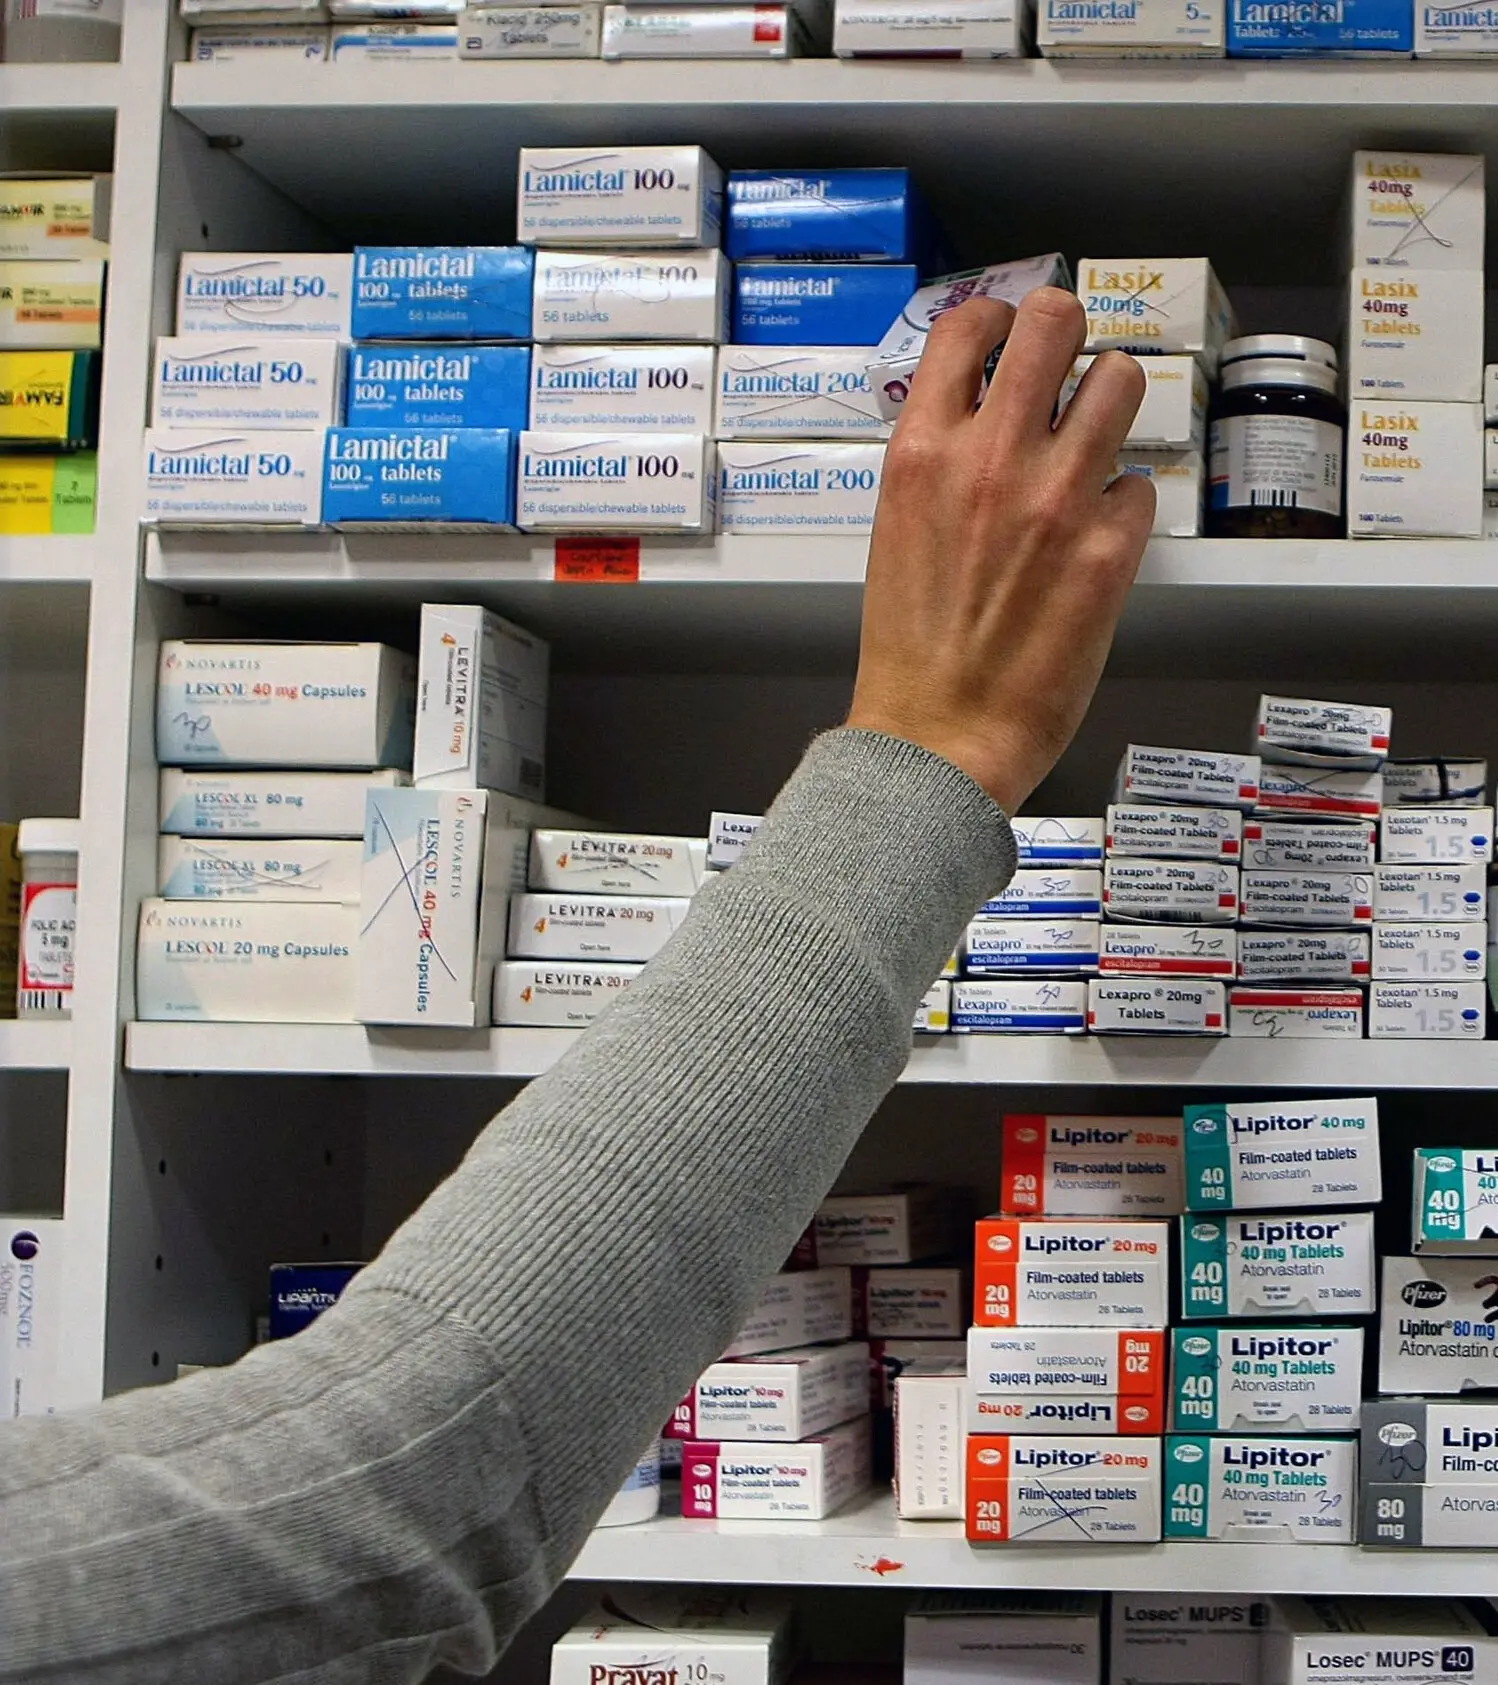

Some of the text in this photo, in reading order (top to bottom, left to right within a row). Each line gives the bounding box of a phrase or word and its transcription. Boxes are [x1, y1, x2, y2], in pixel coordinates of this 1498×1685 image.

[524, 169, 674, 193] Lamictal 100
[524, 216, 536, 226] 56
[649, 215, 681, 225] tablets
[1088, 267, 1163, 290] Lasix
[1362, 278, 1418, 297] Lasix
[1087, 296, 1144, 315] 20mg
[1362, 300, 1408, 317] 40mg
[1088, 319, 1161, 337] Tablets
[1362, 320, 1420, 335] Tablets
[330, 435, 448, 460] Lamictal
[149, 454, 291, 475] Lamictal 50
[330, 464, 441, 481] 100 tablets
[722, 469, 873, 491] Lamictal 200
[382, 493, 440, 505] 56 tablets
[186, 660, 260, 669] NOVARTIS
[455, 647, 468, 716] LEVITRA
[185, 684, 366, 700] LESCOL 40 mg Capsules
[1115, 811, 1199, 825] Lexapro 20mg
[1114, 825, 1217, 838] Film-coated Tablets
[549, 905, 653, 921] LEVITRA 20 mg
[166, 942, 348, 958] LESCOL 20 mg Capsules
[1099, 988, 1202, 1003] Lexapro 20mg
[1425, 988, 1438, 997] 1.5
[1442, 989, 1458, 999] mg
[1118, 1007, 1165, 1019] Tablets
[1415, 1009, 1455, 1031] 1.5
[1113, 1241, 1132, 1252] 20
[1134, 1242, 1157, 1255] mg
[1026, 1272, 1144, 1284] Film-coated tablets
[1404, 1287, 1447, 1303] Pfizer
[1454, 1321, 1470, 1336] 80
[1474, 1324, 1495, 1340] mg
[1400, 1343, 1489, 1358] Atorvastatin
[978, 1402, 1000, 1415] mg
[1004, 1405, 1023, 1416] 20
[1378, 1499, 1405, 1518] 80
[1378, 1524, 1405, 1541] mg
[1445, 1652, 1469, 1667] 40
[686, 1664, 708, 1681] 10
